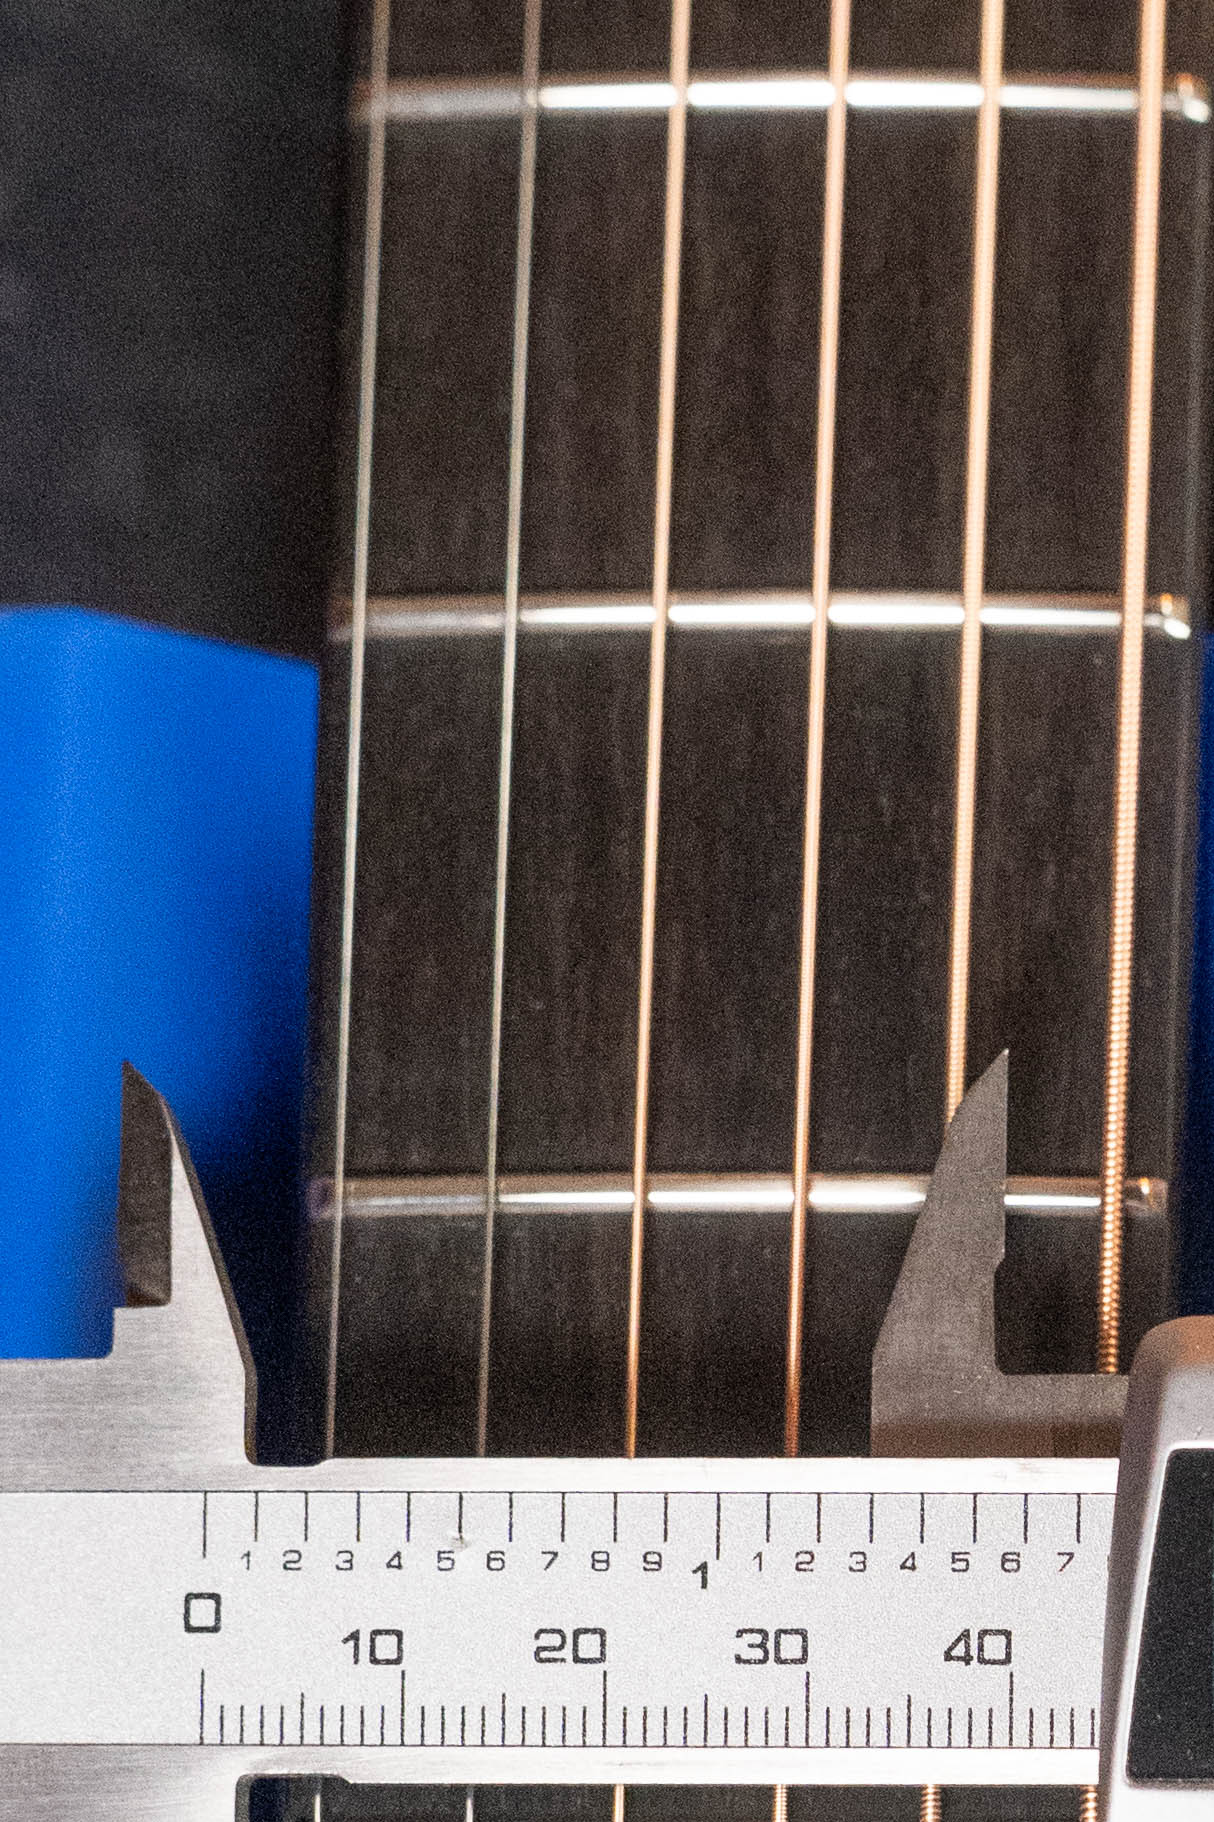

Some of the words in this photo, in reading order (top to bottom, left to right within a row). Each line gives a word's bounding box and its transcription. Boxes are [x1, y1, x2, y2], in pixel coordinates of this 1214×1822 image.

[240, 1551, 252, 1571] 1
[282, 1550, 302, 1571] 2
[335, 1550, 355, 1571] 3
[386, 1551, 403, 1571] 4
[436, 1550, 456, 1571] 5
[486, 1550, 506, 1571] 6
[541, 1551, 560, 1571] 7
[591, 1551, 610, 1572] 8
[642, 1551, 662, 1572] 9
[692, 1561, 709, 1590] 1
[751, 1551, 764, 1573] 1
[794, 1551, 815, 1572] 2
[848, 1551, 868, 1573] 3
[899, 1552, 918, 1573] 4
[950, 1552, 970, 1573] 5
[1000, 1552, 1021, 1573] 6
[1056, 1552, 1075, 1573] 7
[184, 1592, 222, 1634] 0
[341, 1629, 404, 1666] 10
[533, 1628, 607, 1665] 20
[734, 1628, 809, 1665] 30
[943, 1628, 1013, 1666] 40
